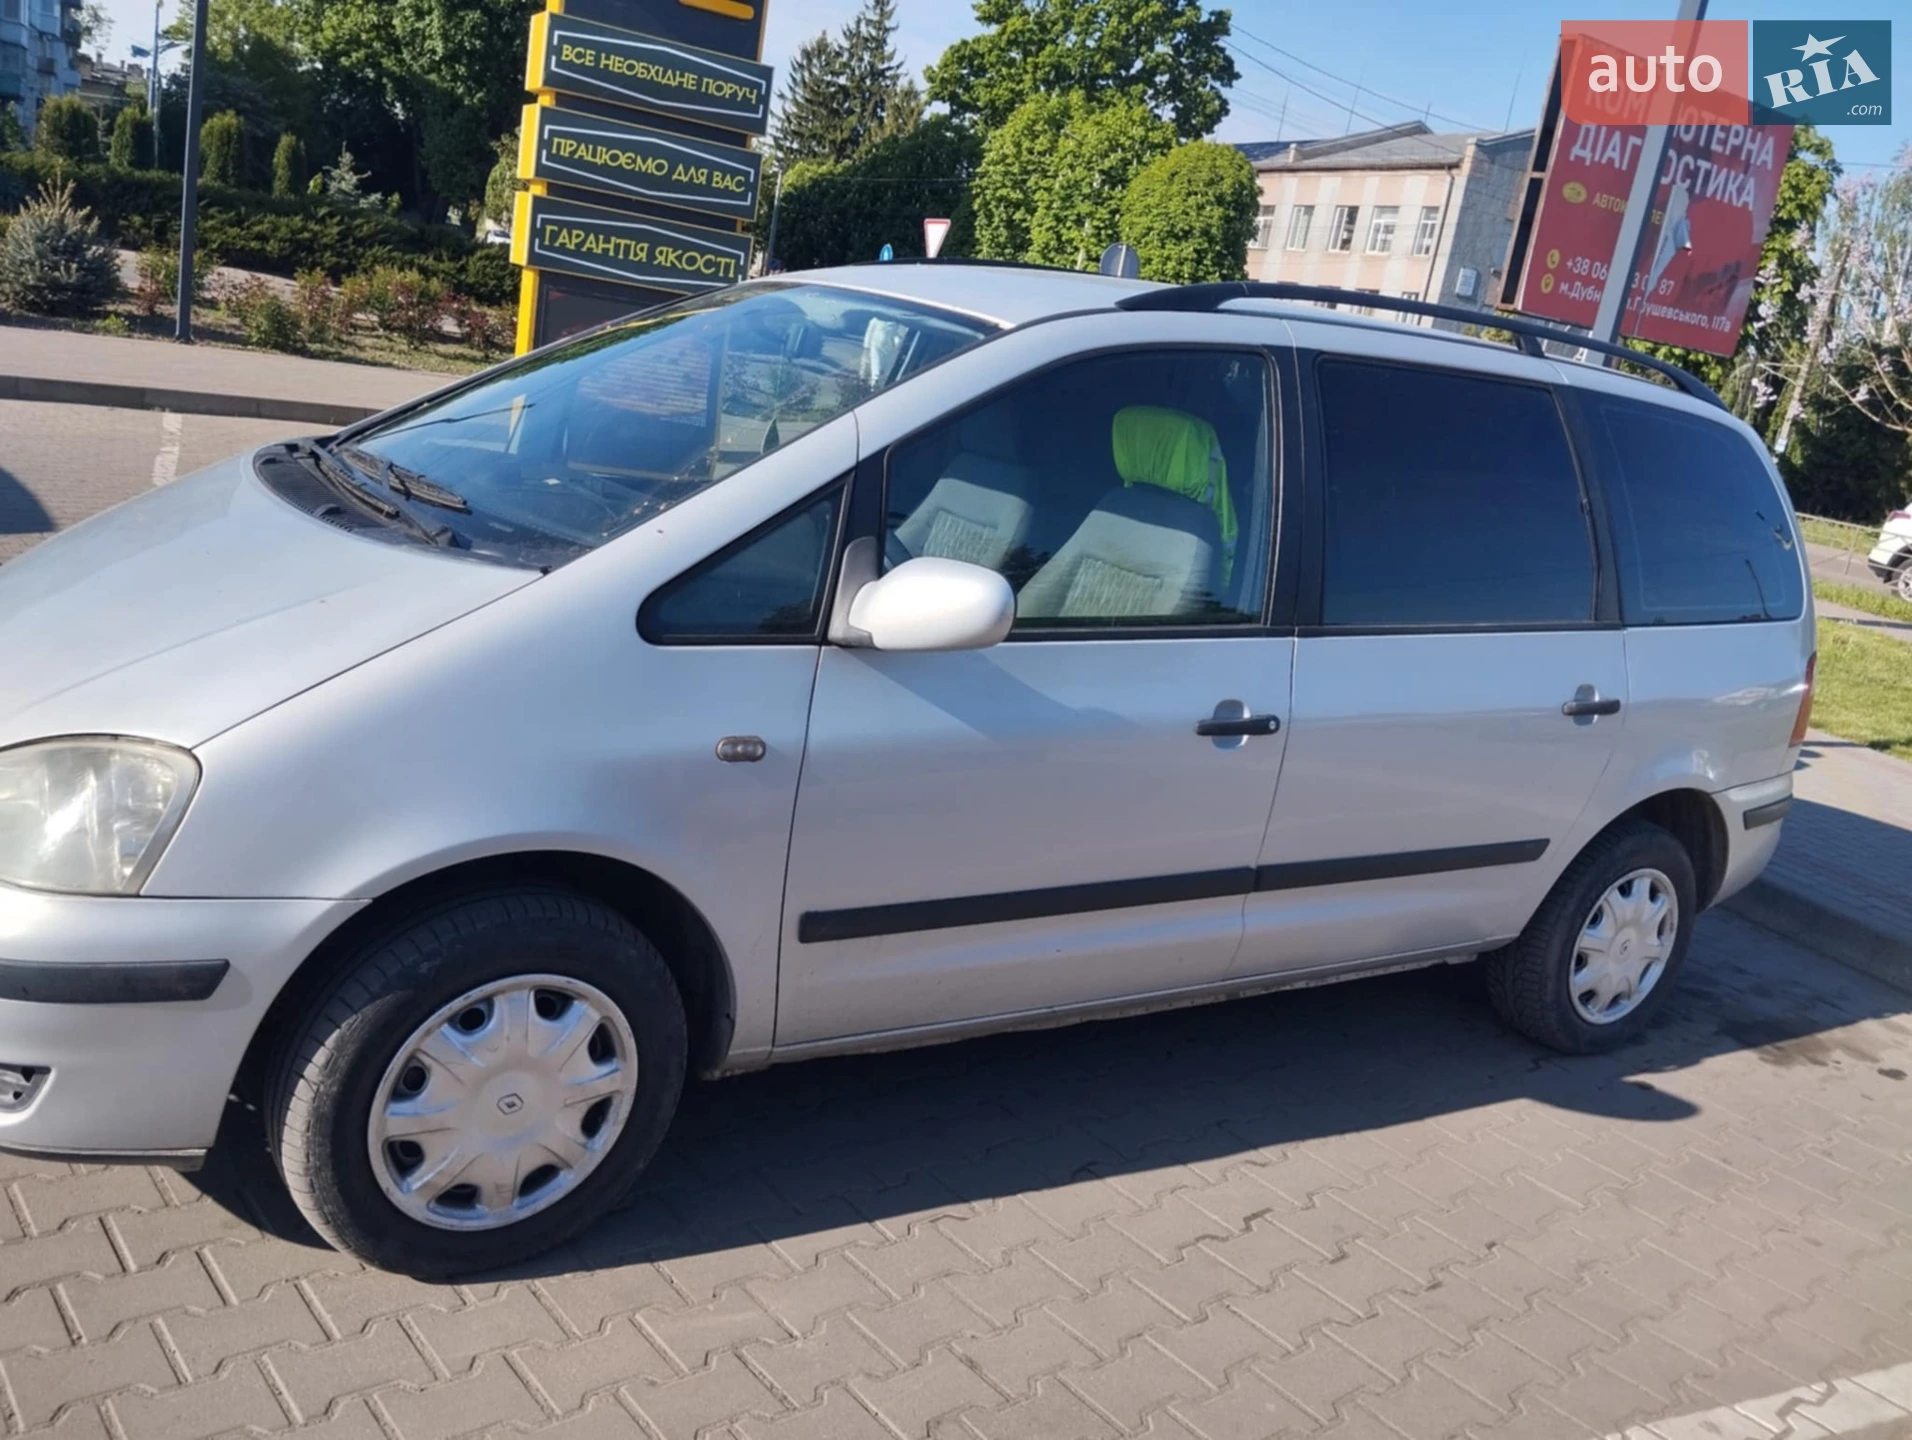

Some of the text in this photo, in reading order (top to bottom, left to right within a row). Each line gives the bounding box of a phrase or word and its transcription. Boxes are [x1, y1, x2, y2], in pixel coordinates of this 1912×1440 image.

[561, 44, 757, 104] ВСЕ НЕОБХІДНЕ ПОРУЧ
[552, 137, 745, 192] ПРАЦЮЄМО ДЛЯ ВАС
[1570, 120, 1756, 211] ДІАГОСТИКА
[544, 225, 736, 278] ГАРАНТІЯ ЯКОСТІ
[1565, 256, 1589, 276] +38
[1591, 264, 1608, 281] 06
[1558, 281, 1601, 303] м.Дубн
